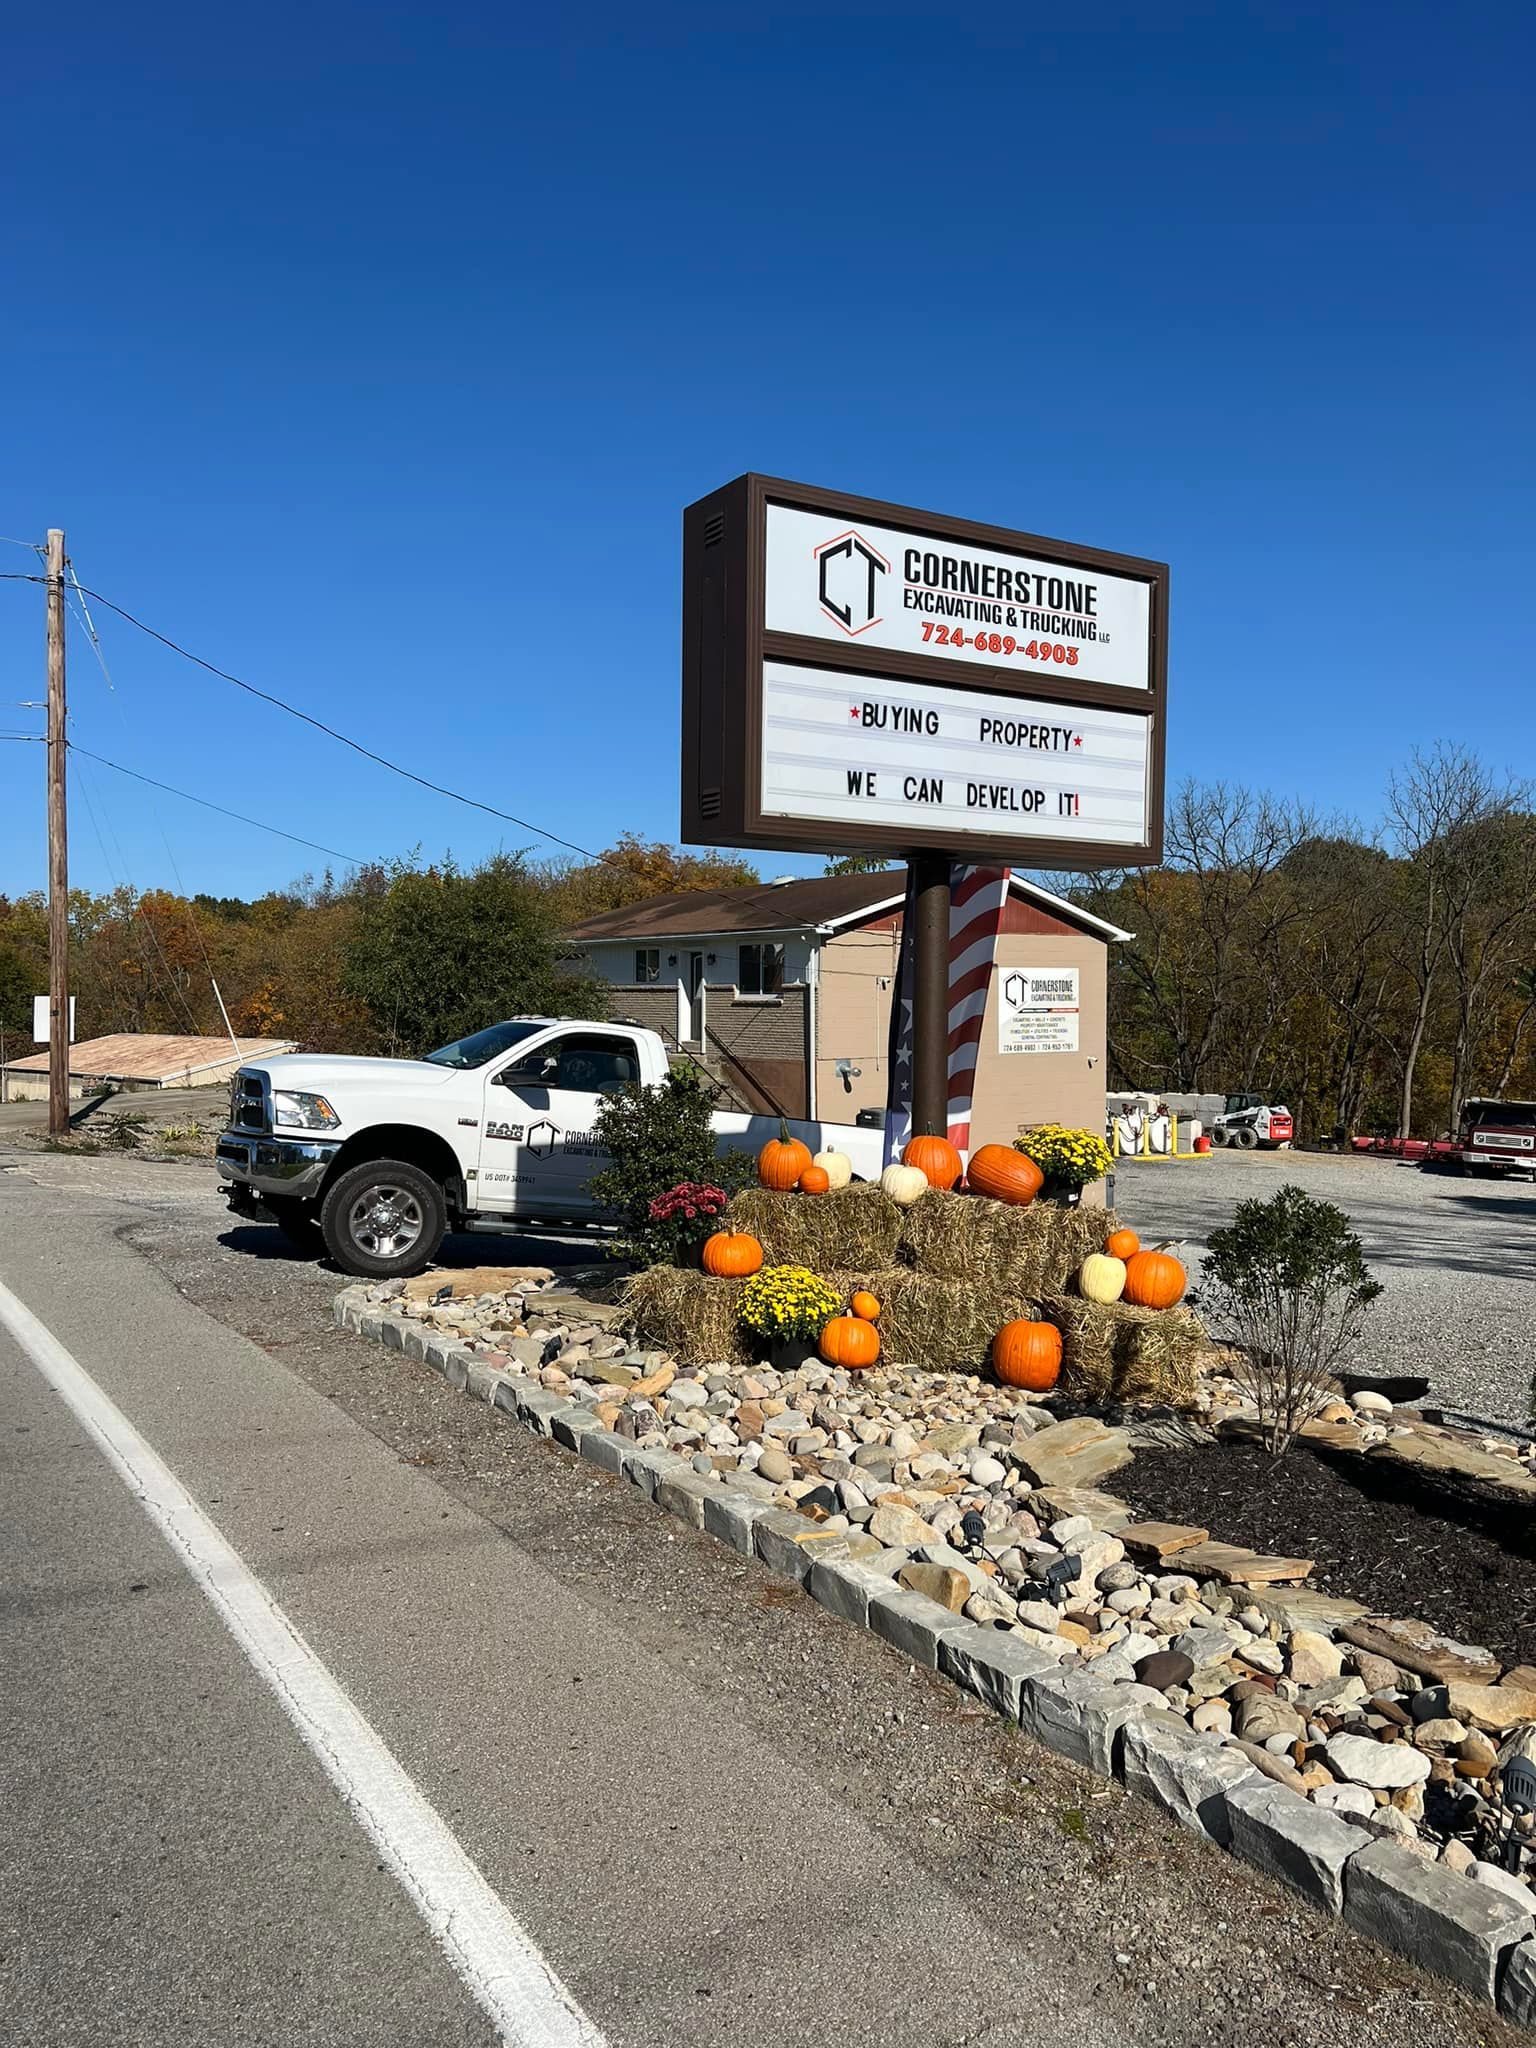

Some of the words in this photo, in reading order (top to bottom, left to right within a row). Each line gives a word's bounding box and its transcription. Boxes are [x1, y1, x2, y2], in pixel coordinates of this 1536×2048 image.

[904, 549, 1097, 617] CORNERSTONE
[904, 588, 1002, 625] EXCAVATING
[1006, 607, 1018, 628] &
[1020, 610, 1097, 641] TRUCKING
[1099, 632, 1110, 643] LLC
[921, 621, 1079, 666] 724-689-4903
[862, 702, 939, 735] BUYING
[980, 718, 1073, 751] PROPERTY
[847, 770, 877, 797] WE
[904, 776, 943, 803] CAN
[967, 783, 1045, 813] DEVELOP
[1059, 792, 1079, 816] IT!
[1031, 980, 1073, 992] CORNERSTONE
[486, 1128, 524, 1137] 2500
[487, 1121, 524, 1131] RAM
[484, 1173, 494, 1181] US
[494, 1173, 510, 1182] DOT#
